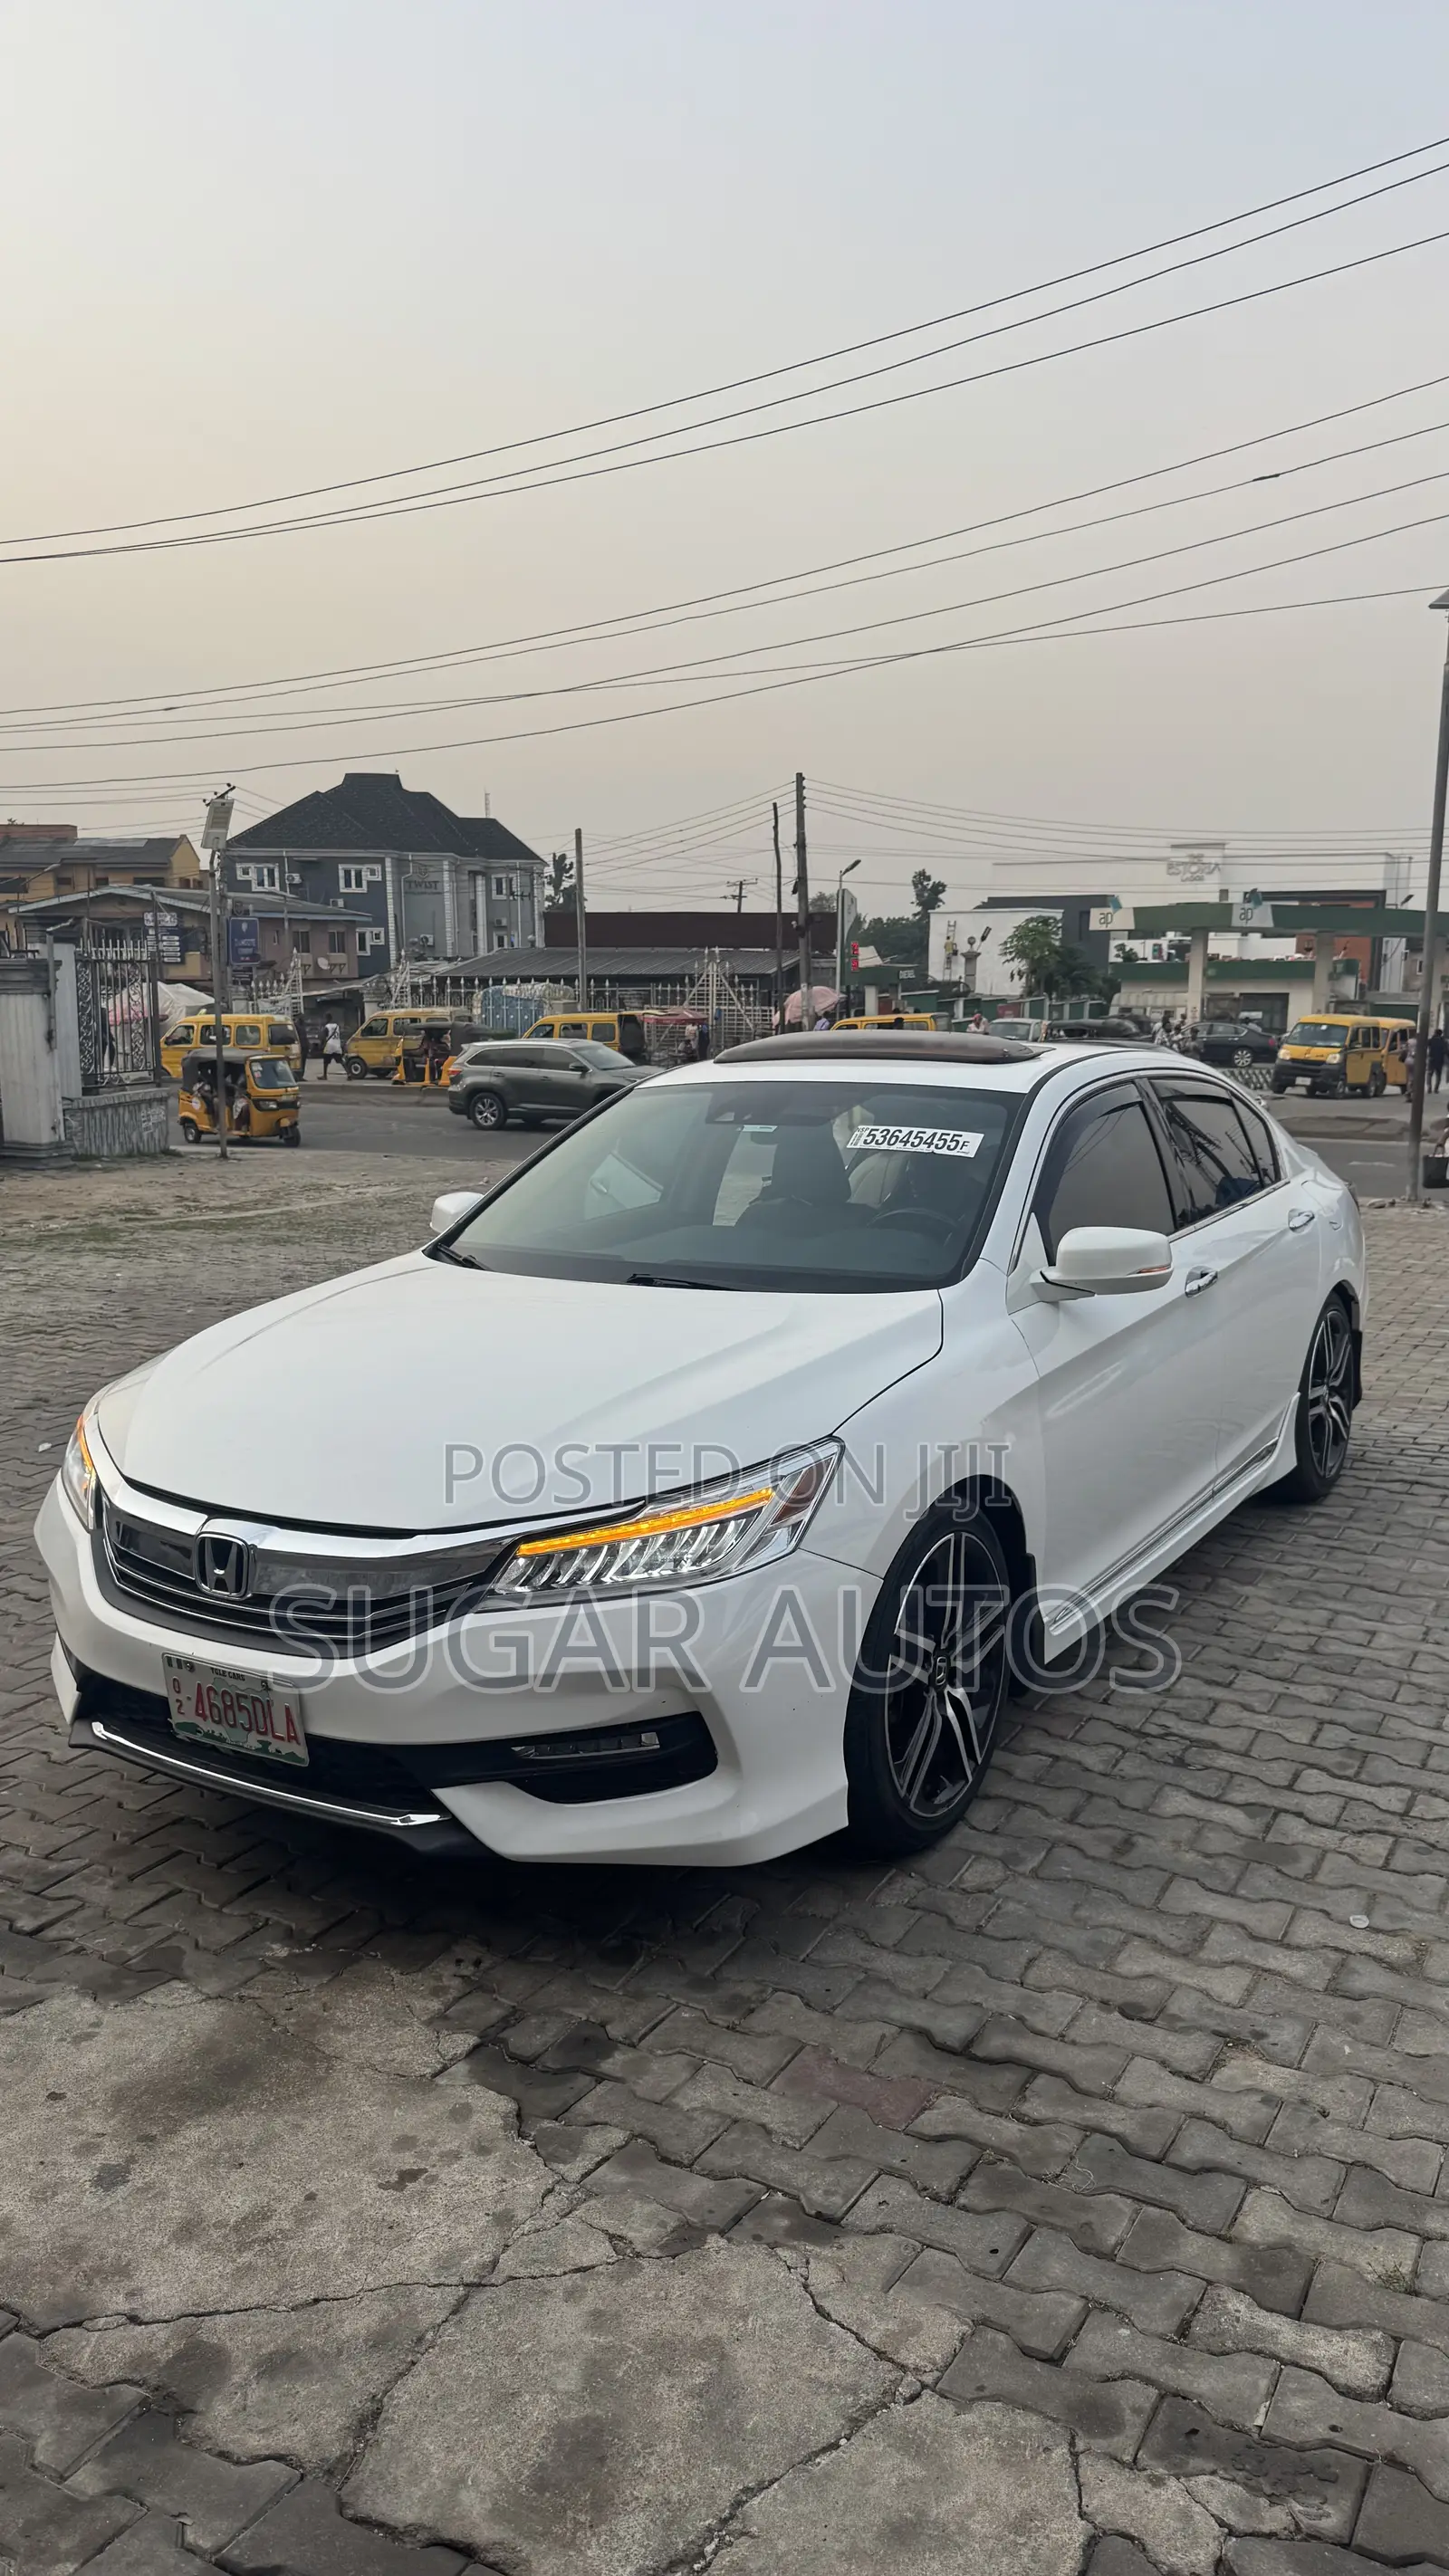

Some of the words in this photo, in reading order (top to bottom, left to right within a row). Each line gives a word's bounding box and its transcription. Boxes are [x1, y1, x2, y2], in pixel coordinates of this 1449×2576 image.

[405, 879, 440, 890] TWIST
[1099, 912, 1114, 928] ap
[1239, 907, 1254, 924] ap
[862, 1128, 964, 1152] 53645455
[960, 1140, 971, 1151] F
